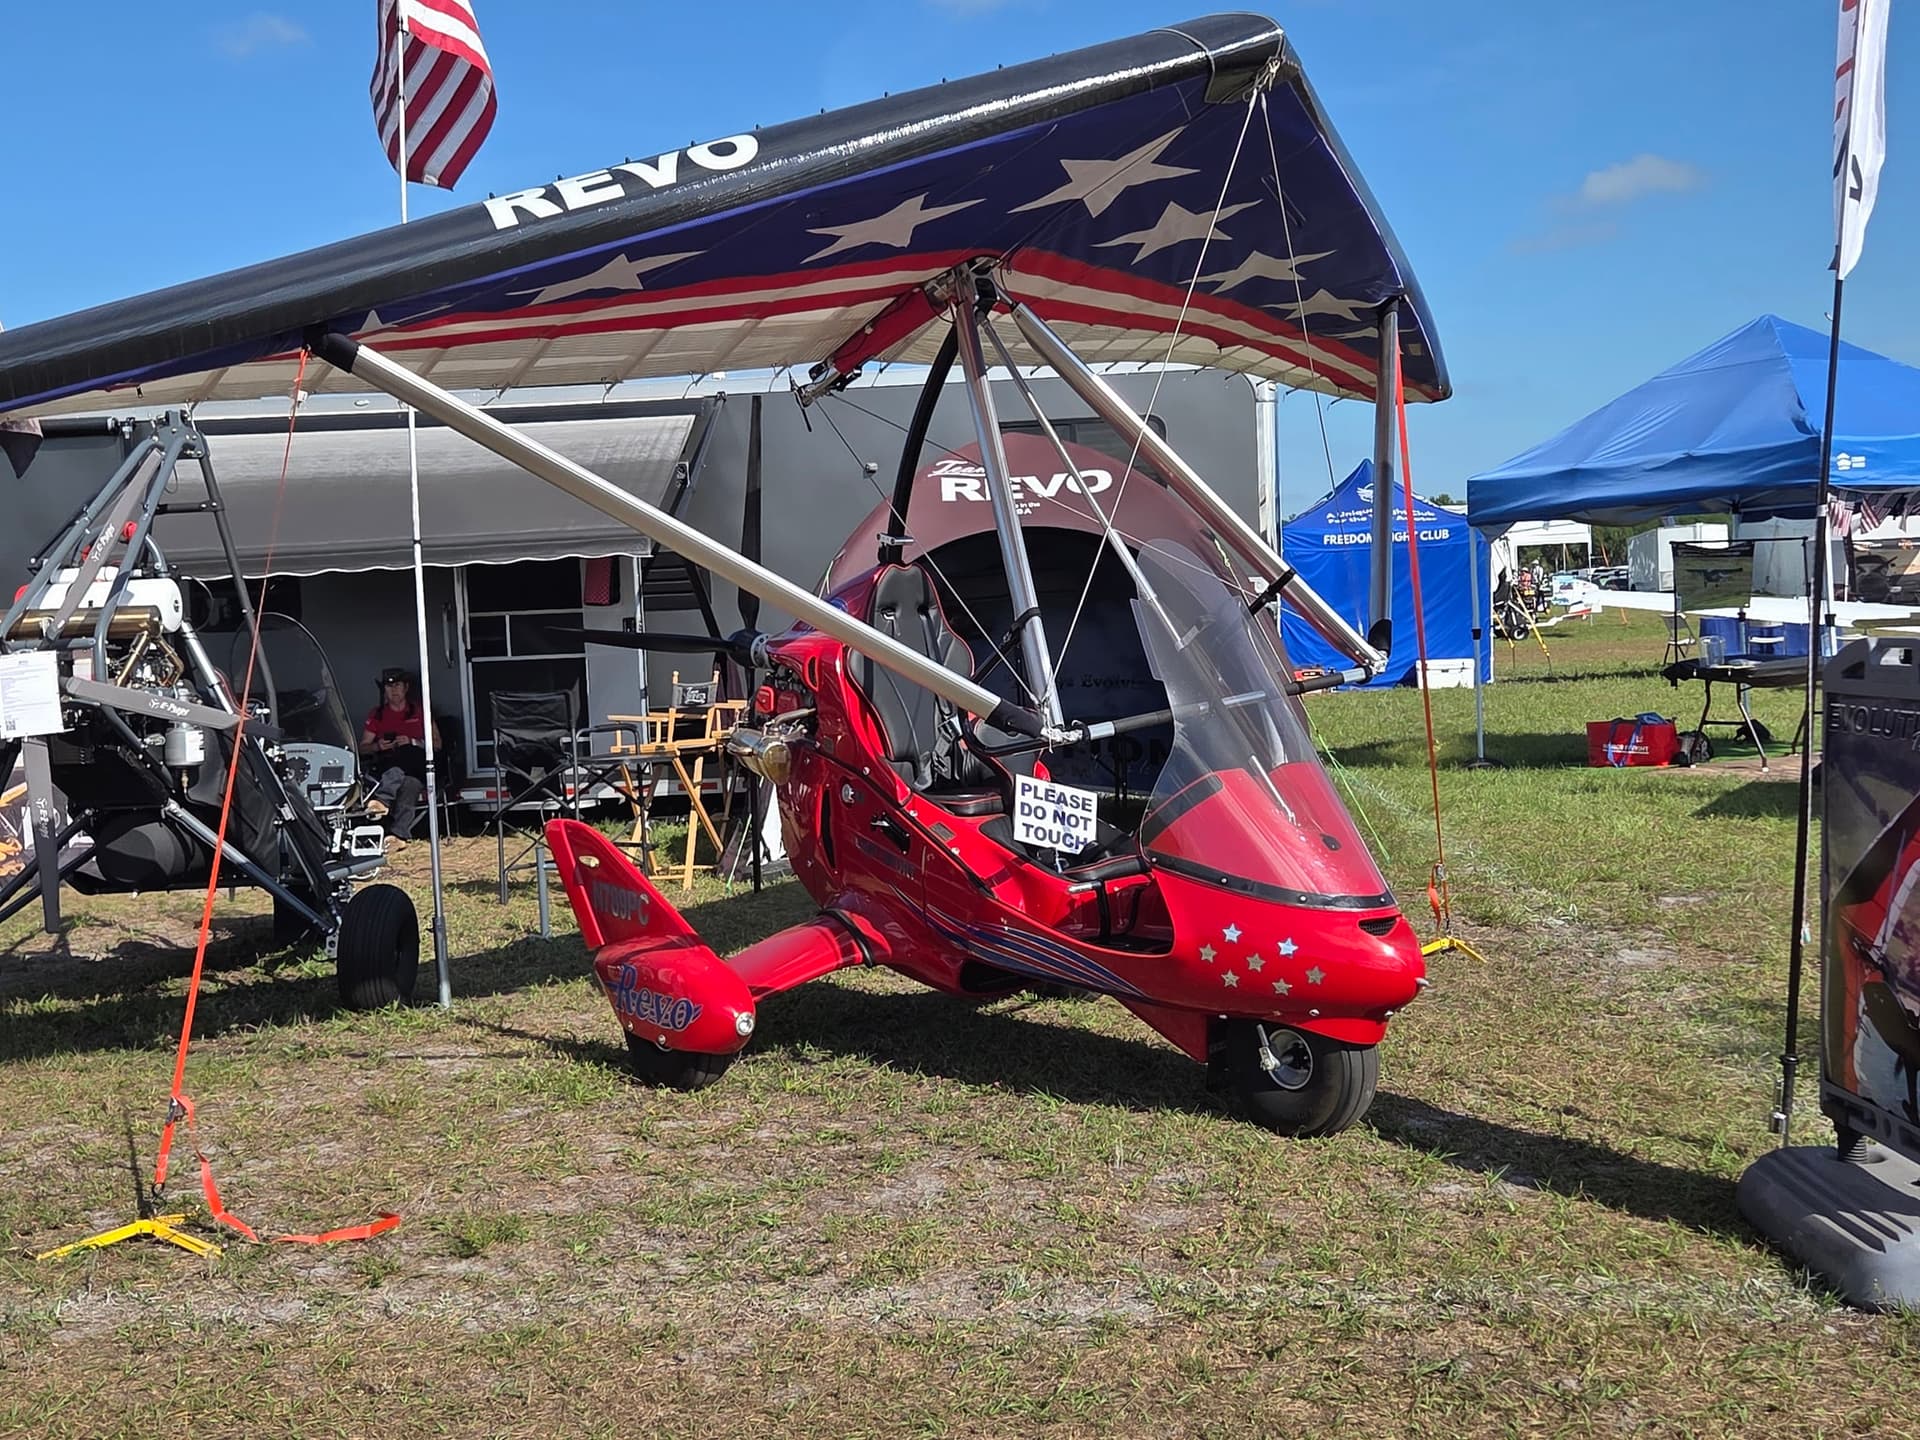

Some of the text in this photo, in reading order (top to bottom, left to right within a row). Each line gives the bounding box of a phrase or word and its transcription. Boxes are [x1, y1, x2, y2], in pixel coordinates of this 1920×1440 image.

[483, 134, 759, 230] REVO
[1339, 508, 1373, 519] Uniqu
[1420, 528, 1450, 541] CLUB
[1021, 782, 1093, 813] PLEASE
[1020, 801, 1092, 831] DO NOT
[1022, 822, 1088, 850] TOUCH
[608, 962, 704, 1032] Revo
